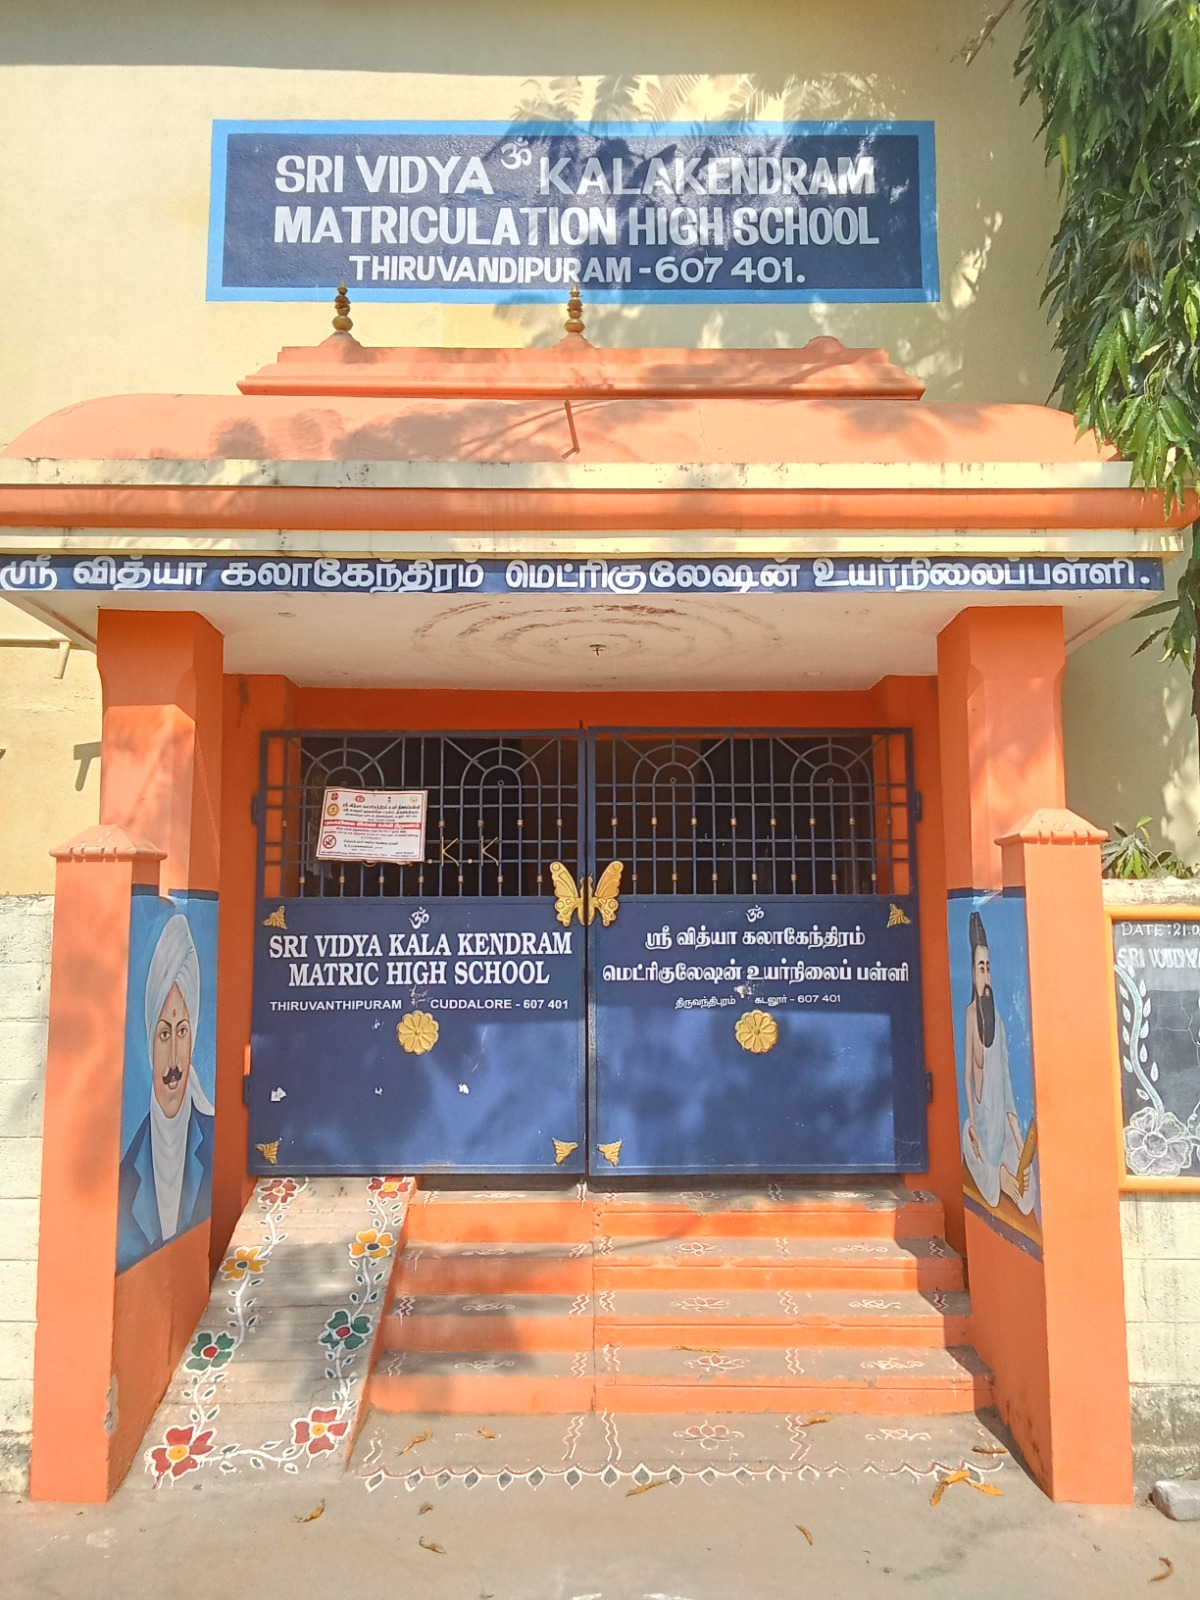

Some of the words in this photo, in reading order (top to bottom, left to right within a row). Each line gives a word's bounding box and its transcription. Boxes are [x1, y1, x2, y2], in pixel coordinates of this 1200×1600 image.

[274, 155, 344, 193] SRI
[355, 155, 495, 195] VIDYA
[273, 205, 617, 247] MATRICULATION
[628, 206, 724, 246] HIGH
[732, 206, 879, 246] SCHOOL
[348, 255, 632, 284] THIRUVANDIPURAM
[73, 555, 208, 591] வித்யா
[220, 557, 484, 594] கலாகேந்திரம்
[505, 556, 800, 594] மெட்ரிகுலேஷன்
[268, 934, 308, 959] SRI
[315, 934, 383, 958] VIDYA
[388, 933, 451, 957] KALA
[457, 931, 573, 956] KENDRAM
[645, 924, 672, 949] ஸ்ரீ
[676, 925, 737, 949] வித்யா
[742, 924, 866, 949] கலாகேந்திரம்
[288, 962, 379, 988] MATRIC
[386, 961, 447, 986] HIGH
[454, 960, 550, 985] SCHOOL
[602, 958, 742, 985] மெட்ரிகுலேஷன்
[747, 957, 852, 985] உயர்நிலைப்
[857, 960, 909, 982] பள்ளி
[269, 1000, 402, 1012] THIRUVANTHIPURAM
[430, 998, 512, 1010] CUDDALORE
[523, 998, 546, 1010] 607
[548, 998, 569, 1010] 401
[754, 994, 787, 1007] கடலூர்
[797, 994, 819, 1004] 607
[822, 993, 842, 1004] 401
